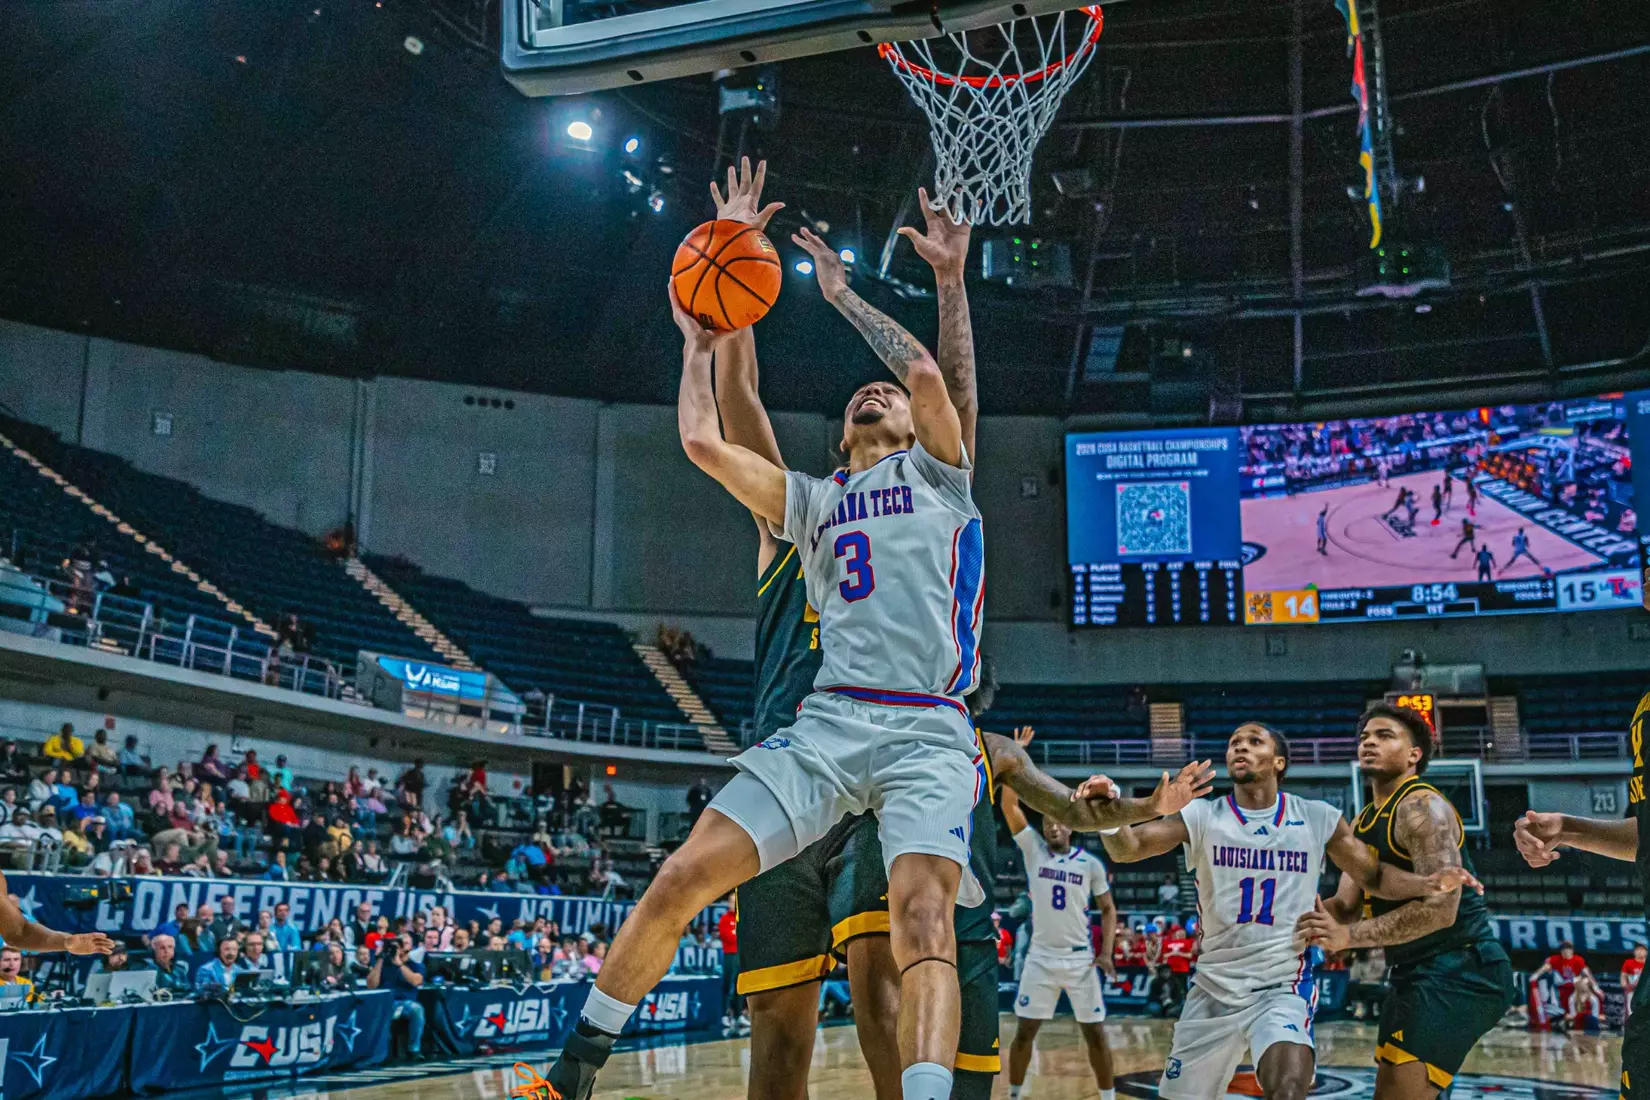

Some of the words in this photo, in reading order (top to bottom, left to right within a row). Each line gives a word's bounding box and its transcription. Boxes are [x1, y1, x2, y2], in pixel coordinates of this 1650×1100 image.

[1118, 440, 1164, 453] BASKETBALL
[1165, 438, 1229, 451] CHAMPIONSHIPS
[1106, 453, 1144, 469] DIGITAL
[1146, 451, 1198, 467] PROGRAM
[870, 485, 914, 518] TECH
[1533, 508, 1639, 557] CENTER
[834, 530, 876, 604] 3
[1411, 583, 1458, 603] 8:54
[1563, 580, 1598, 603] 15
[1284, 596, 1315, 617] 14
[1366, 606, 1393, 617] POSS
[1593, 793, 1616, 812] 213
[1213, 845, 1275, 871] LOUISIANA
[1277, 849, 1308, 873] TECH
[1068, 871, 1083, 886] TECH
[396, 890, 456, 922] USA
[1052, 884, 1066, 911] 8
[1236, 876, 1277, 926] 11
[519, 899, 554, 925] NO
